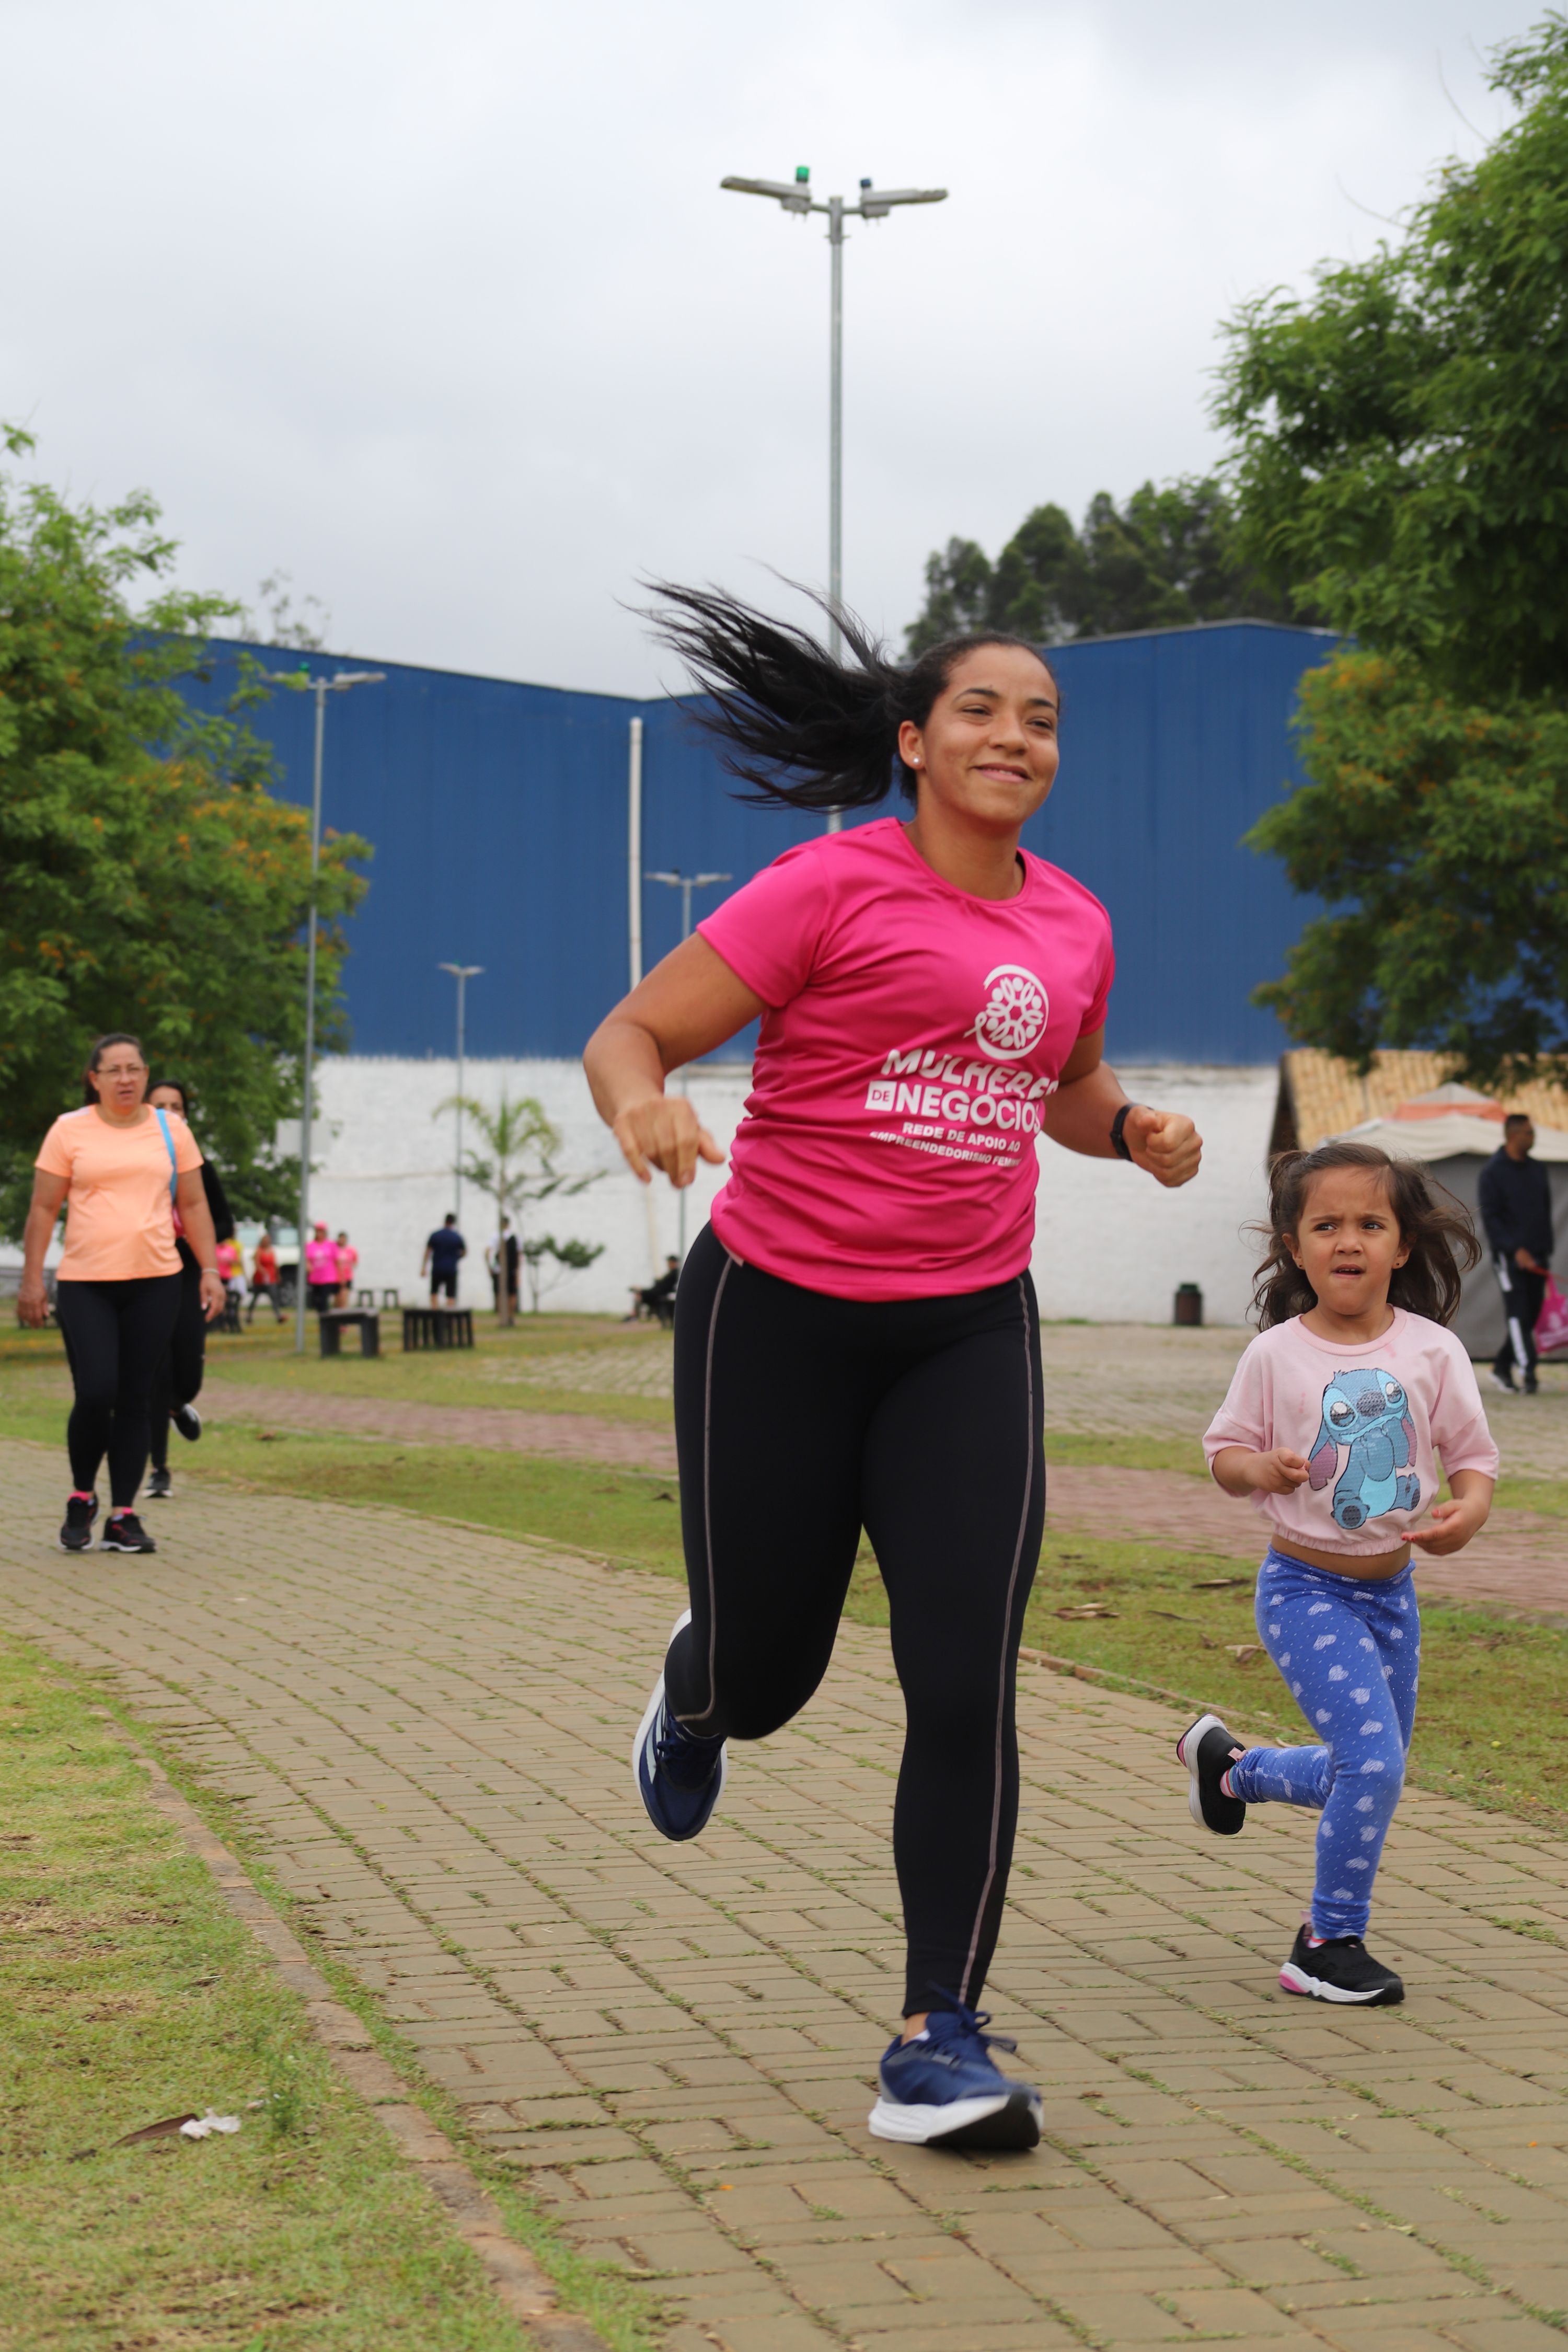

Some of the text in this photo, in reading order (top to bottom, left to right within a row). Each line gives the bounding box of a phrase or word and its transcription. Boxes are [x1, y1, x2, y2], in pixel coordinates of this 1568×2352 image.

[872, 1089, 891, 1102] DE
[902, 1122, 1020, 1152] REDE DE APOIO AO
